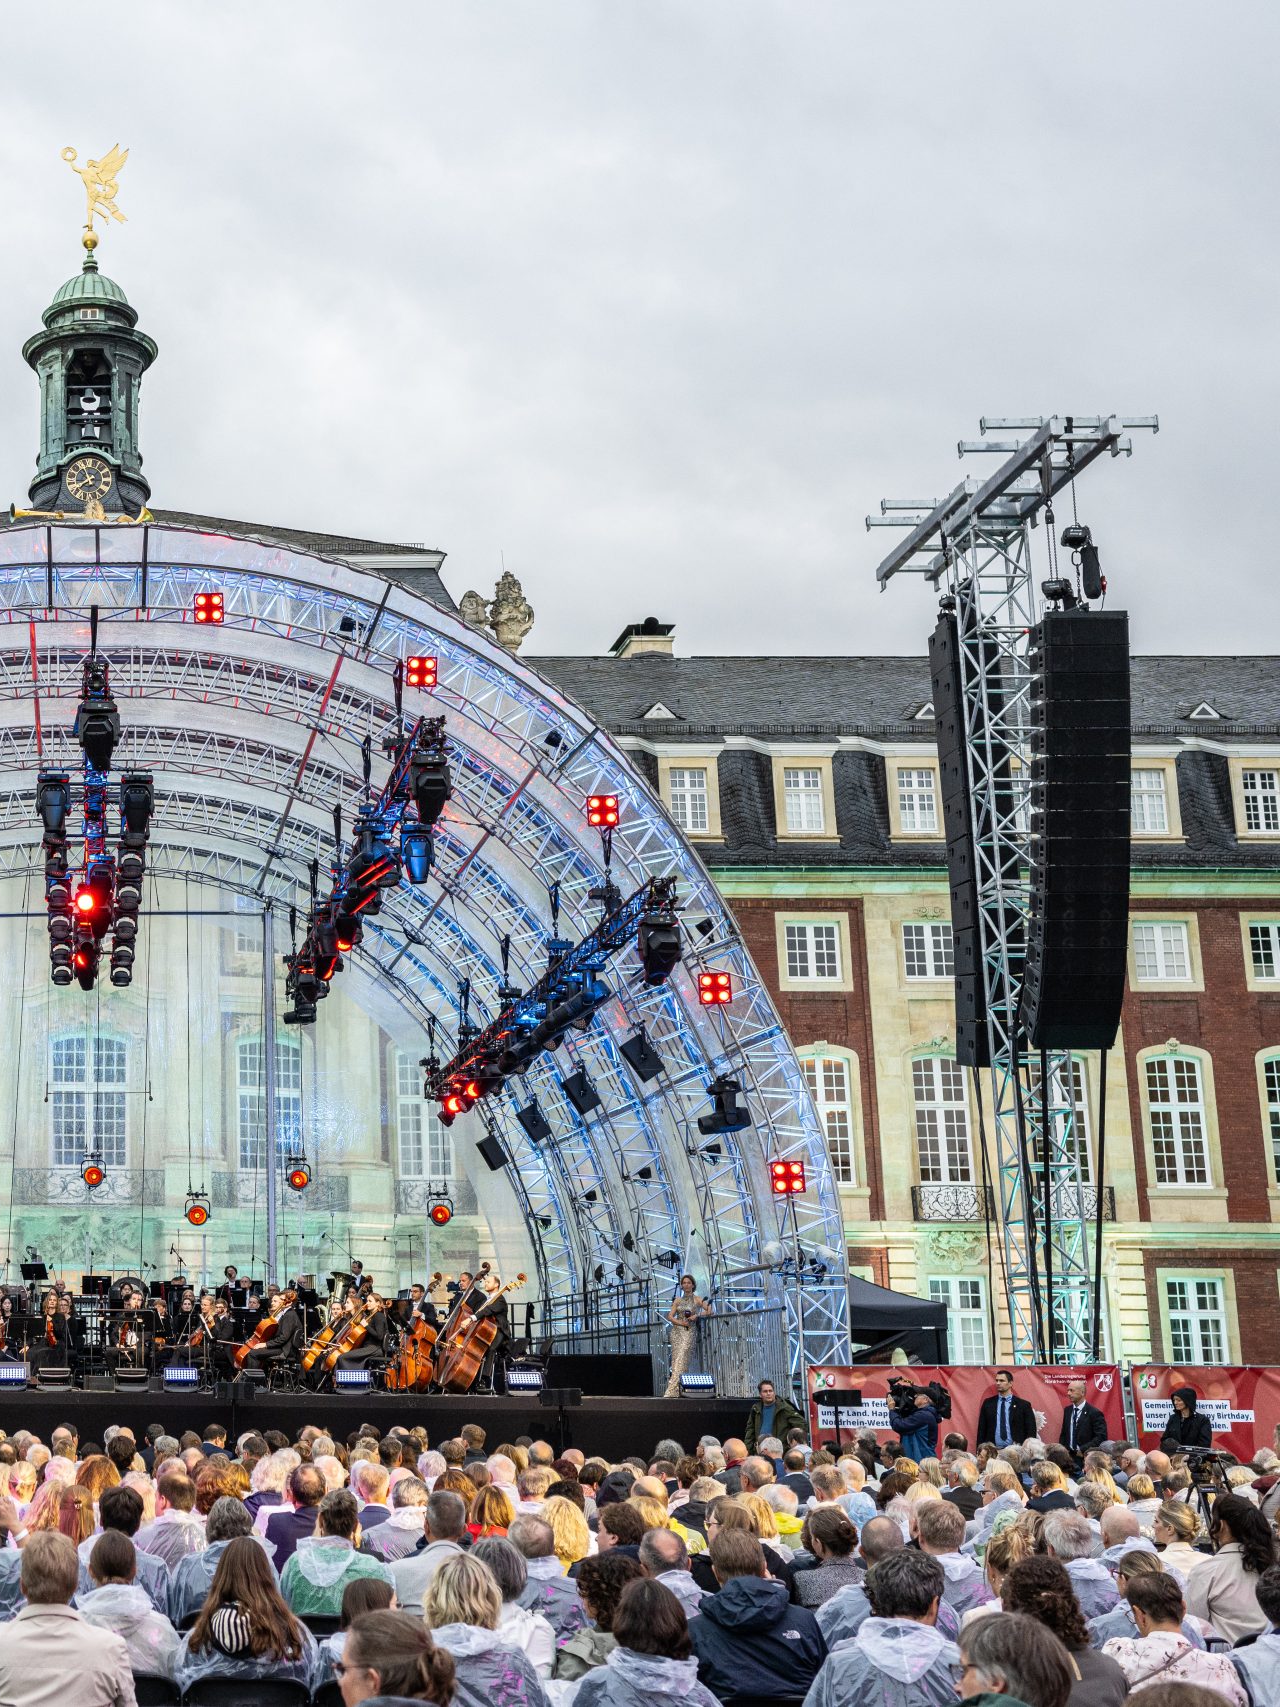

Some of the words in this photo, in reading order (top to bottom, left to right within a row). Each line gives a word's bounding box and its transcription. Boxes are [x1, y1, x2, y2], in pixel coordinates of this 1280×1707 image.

[872, 1400, 887, 1408] feie
[1215, 1402, 1228, 1410] wir
[847, 1409, 870, 1417] Land.
[1216, 1412, 1252, 1421] Birthday,
